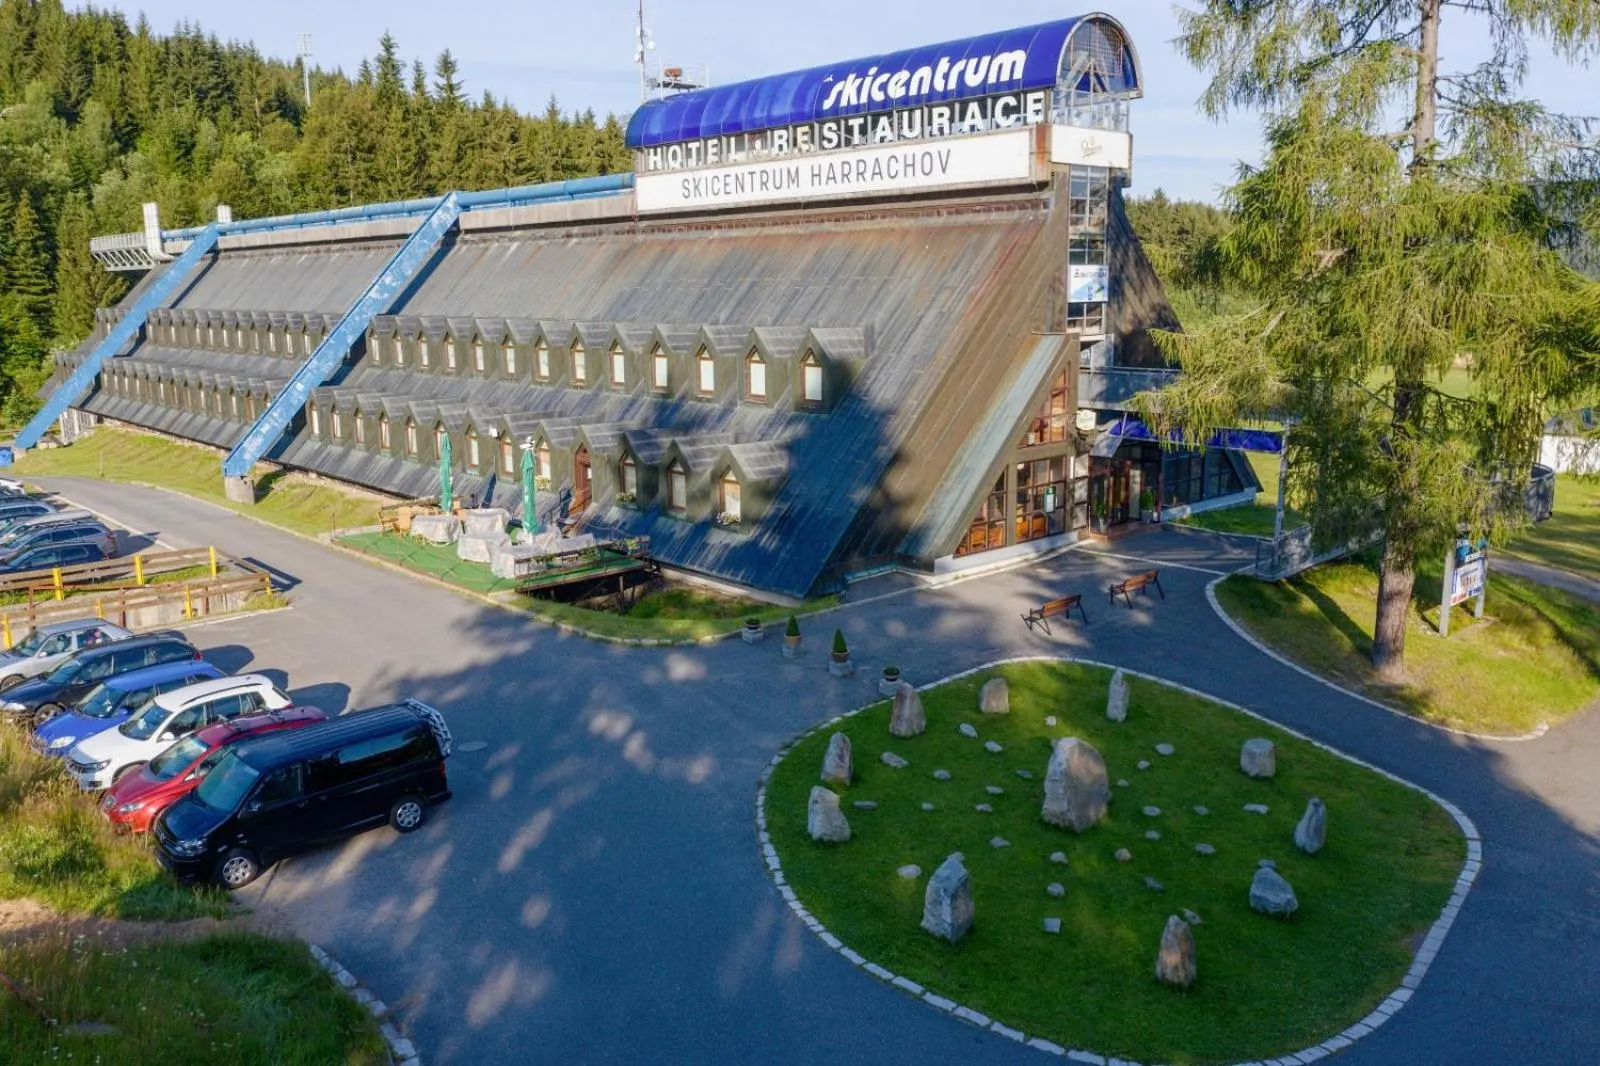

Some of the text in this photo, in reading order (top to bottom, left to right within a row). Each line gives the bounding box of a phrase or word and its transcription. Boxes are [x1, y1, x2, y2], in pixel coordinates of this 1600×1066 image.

[823, 49, 1027, 110] skicentrum
[647, 135, 746, 171] HOTEL
[772, 91, 1046, 157] RESTAURACE
[682, 148, 951, 200] SKICENTRUM HARRACHOV
